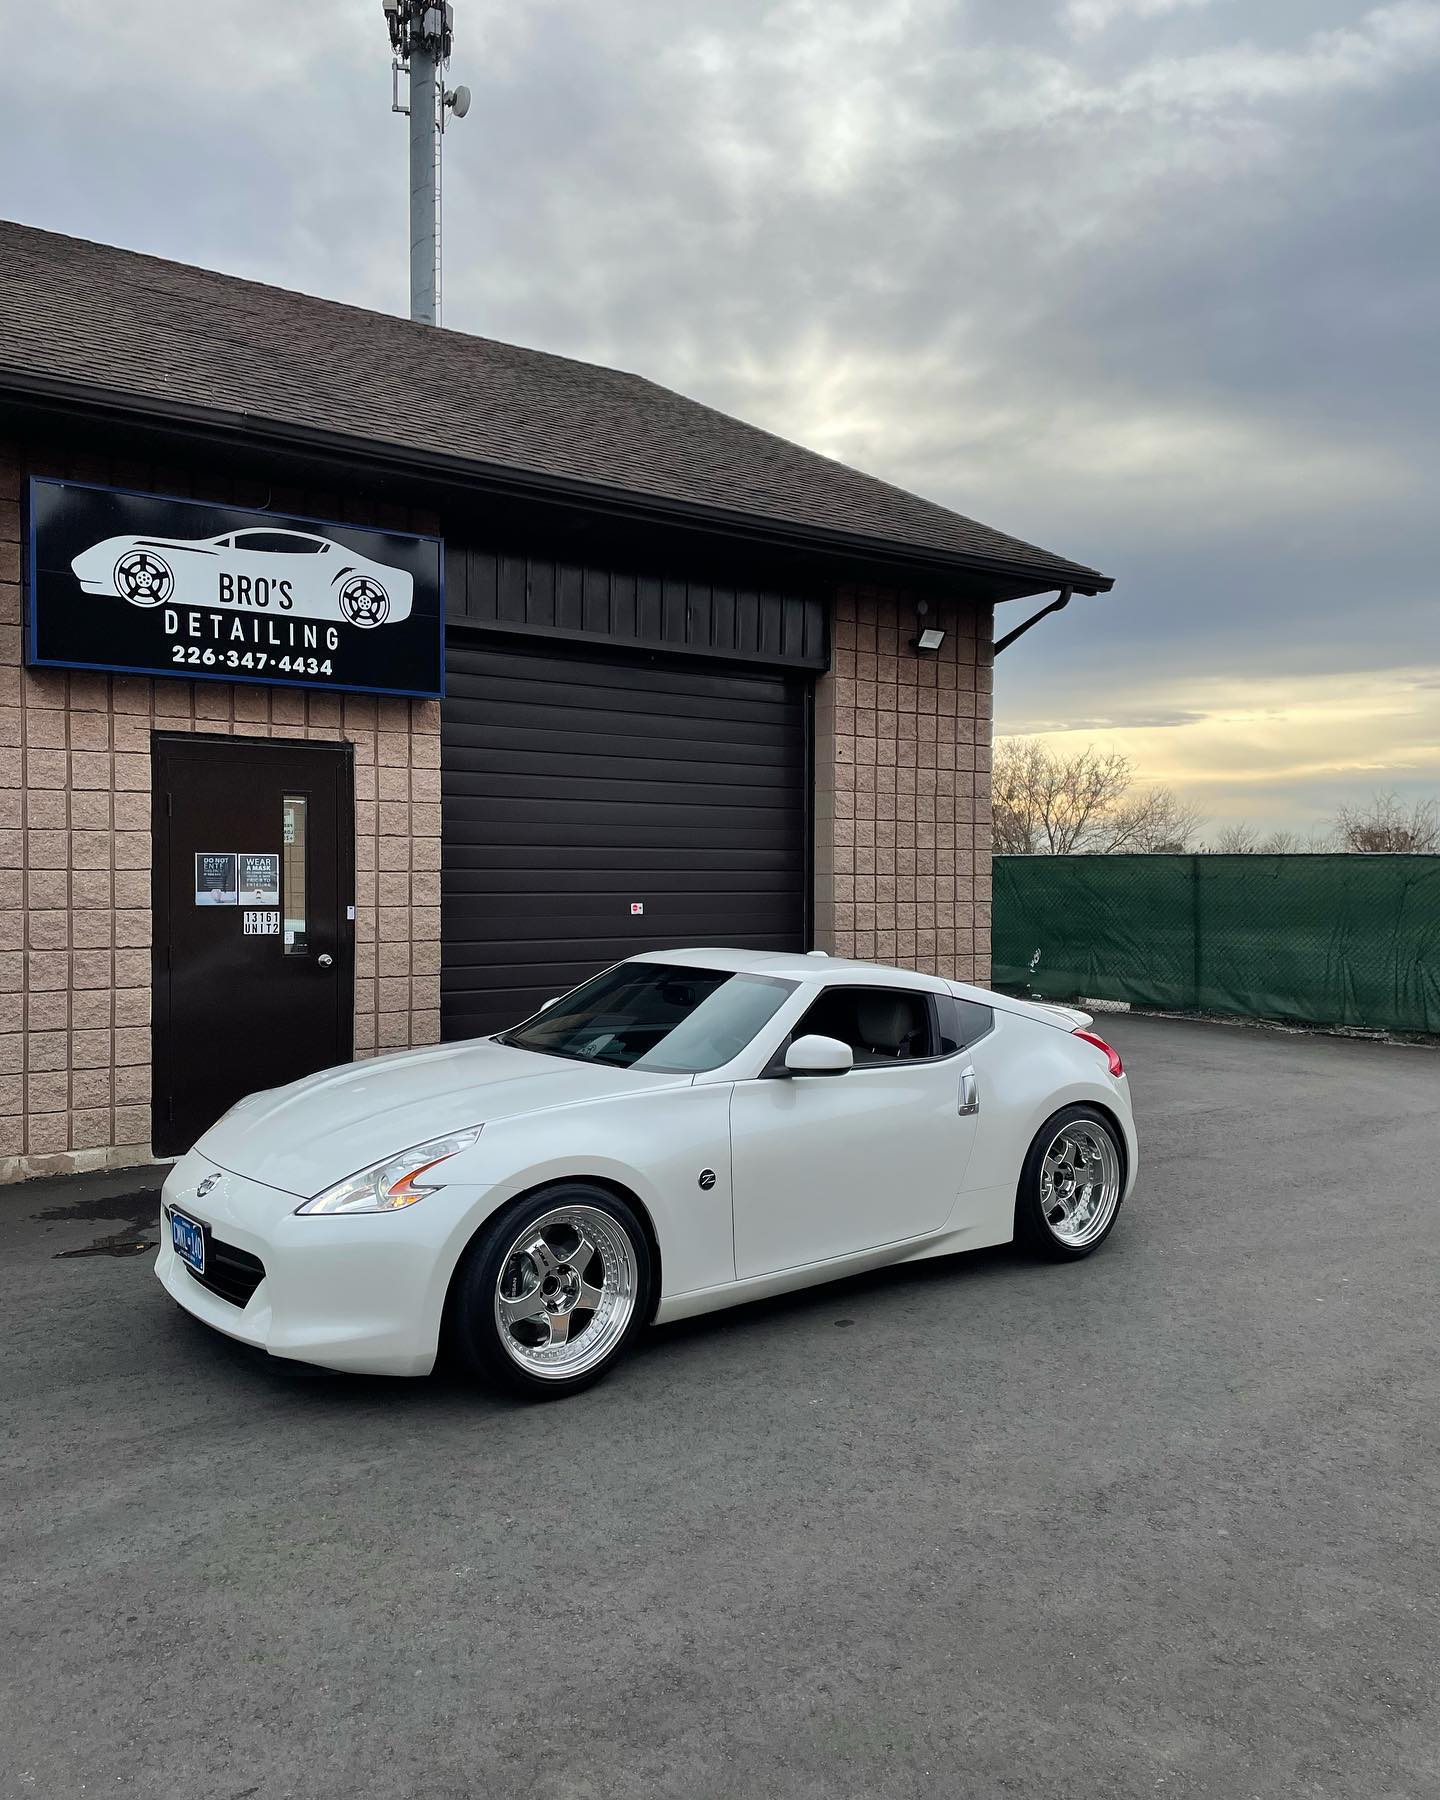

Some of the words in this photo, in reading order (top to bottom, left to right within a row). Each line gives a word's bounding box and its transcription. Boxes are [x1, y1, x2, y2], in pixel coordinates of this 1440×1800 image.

[219, 573, 293, 610] BRO'S
[165, 610, 339, 650] DETAILING
[246, 858, 271, 866] WEAR
[245, 912, 278, 923] 13161
